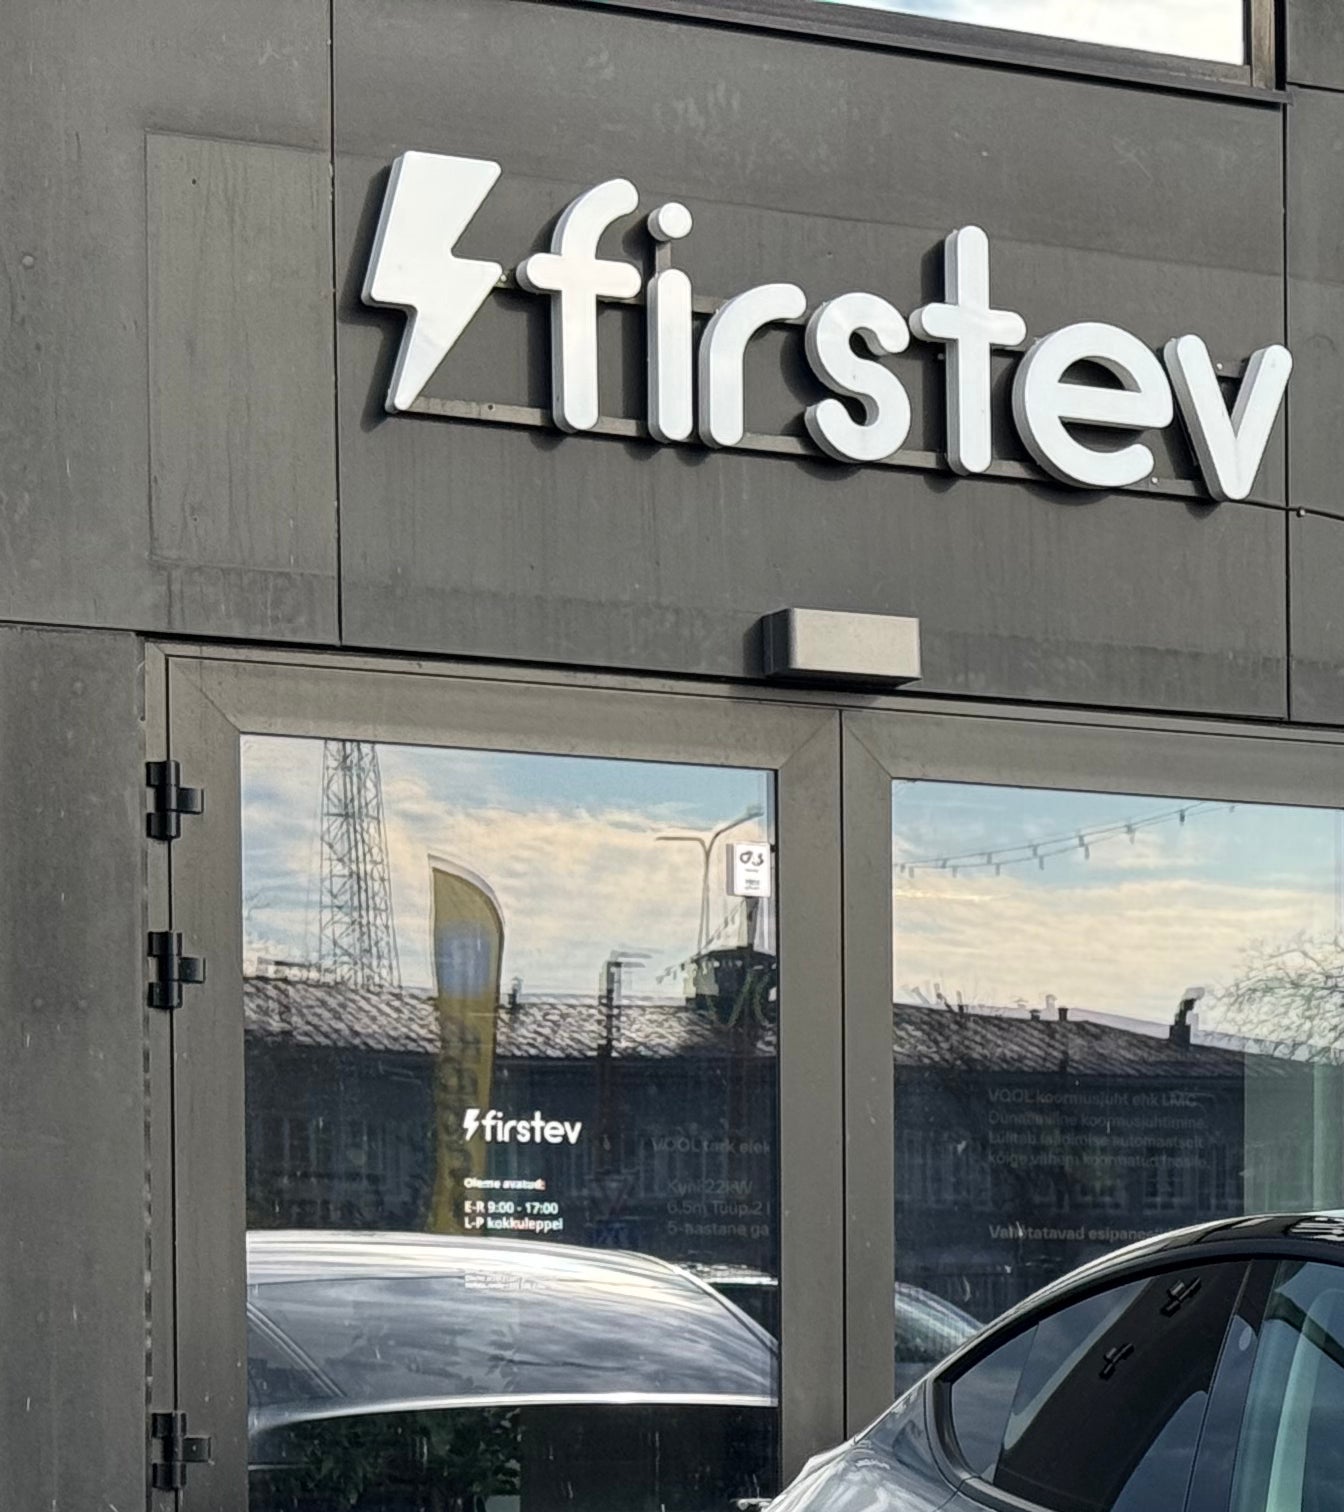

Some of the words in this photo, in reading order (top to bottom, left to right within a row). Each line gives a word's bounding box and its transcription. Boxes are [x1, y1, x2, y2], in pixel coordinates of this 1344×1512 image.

[517, 178, 1292, 501] firstev
[482, 1109, 582, 1144] firstev
[464, 1201, 485, 1213] E-R
[488, 1202, 514, 1213] 9:00
[525, 1202, 558, 1214] 17:00
[464, 1217, 485, 1228] L-P
[487, 1217, 563, 1233] kokkuleppel
